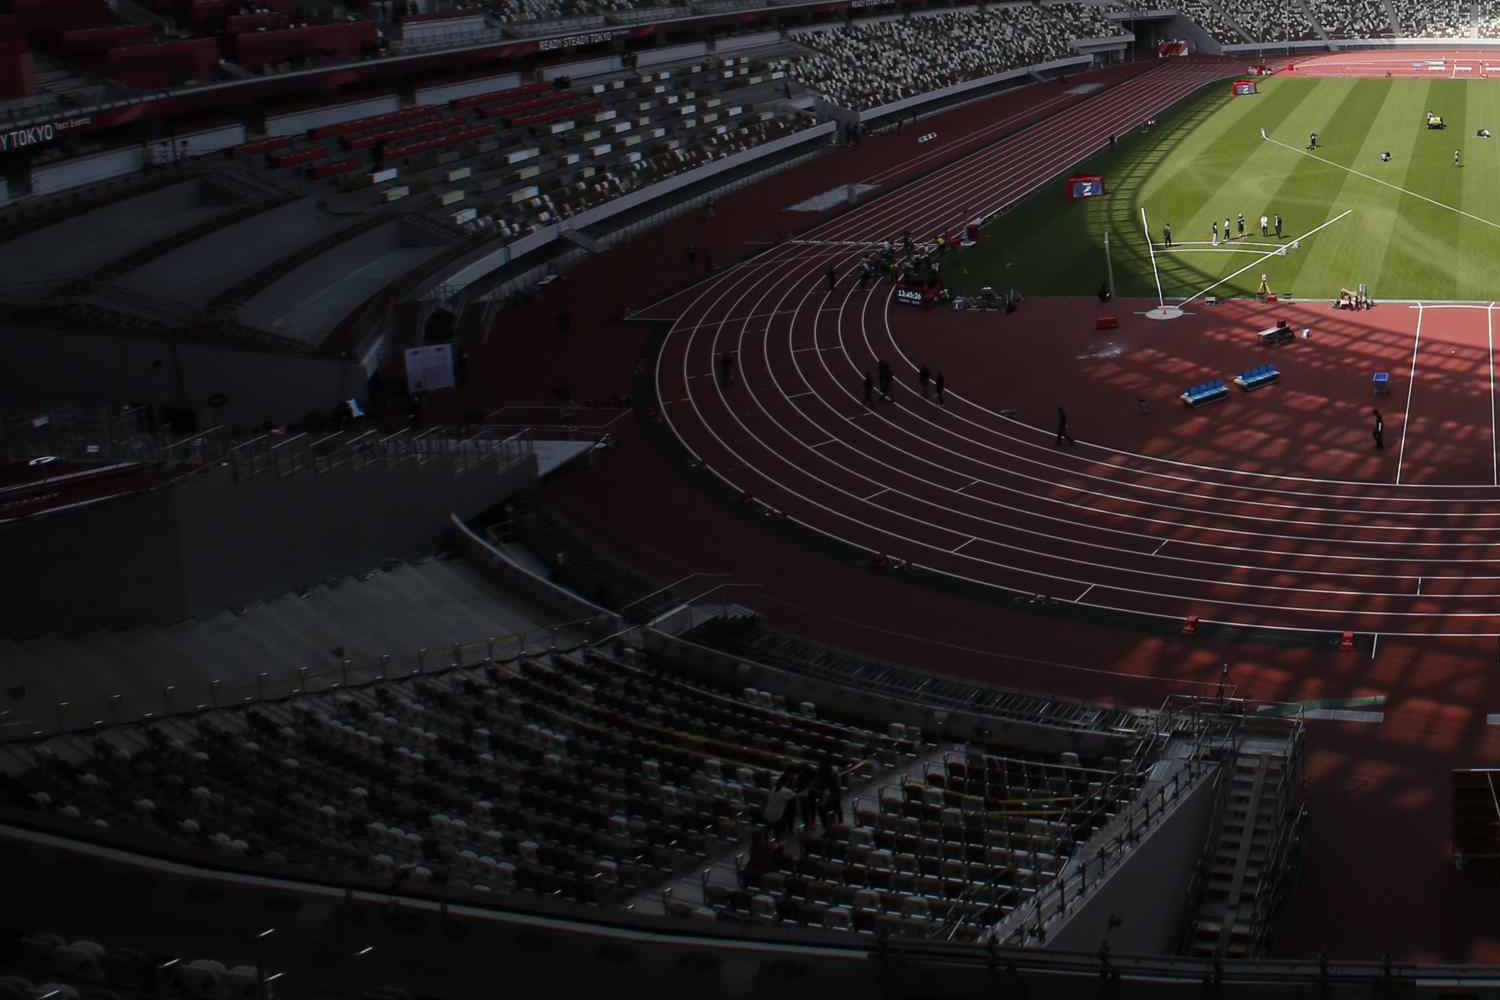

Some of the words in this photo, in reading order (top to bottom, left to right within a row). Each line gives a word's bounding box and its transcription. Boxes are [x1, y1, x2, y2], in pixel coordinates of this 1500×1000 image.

[539, 39, 562, 51] READY
[563, 35, 590, 47] STEADY
[590, 31, 612, 43] TOKYO
[10, 123, 54, 149] TOKYO
